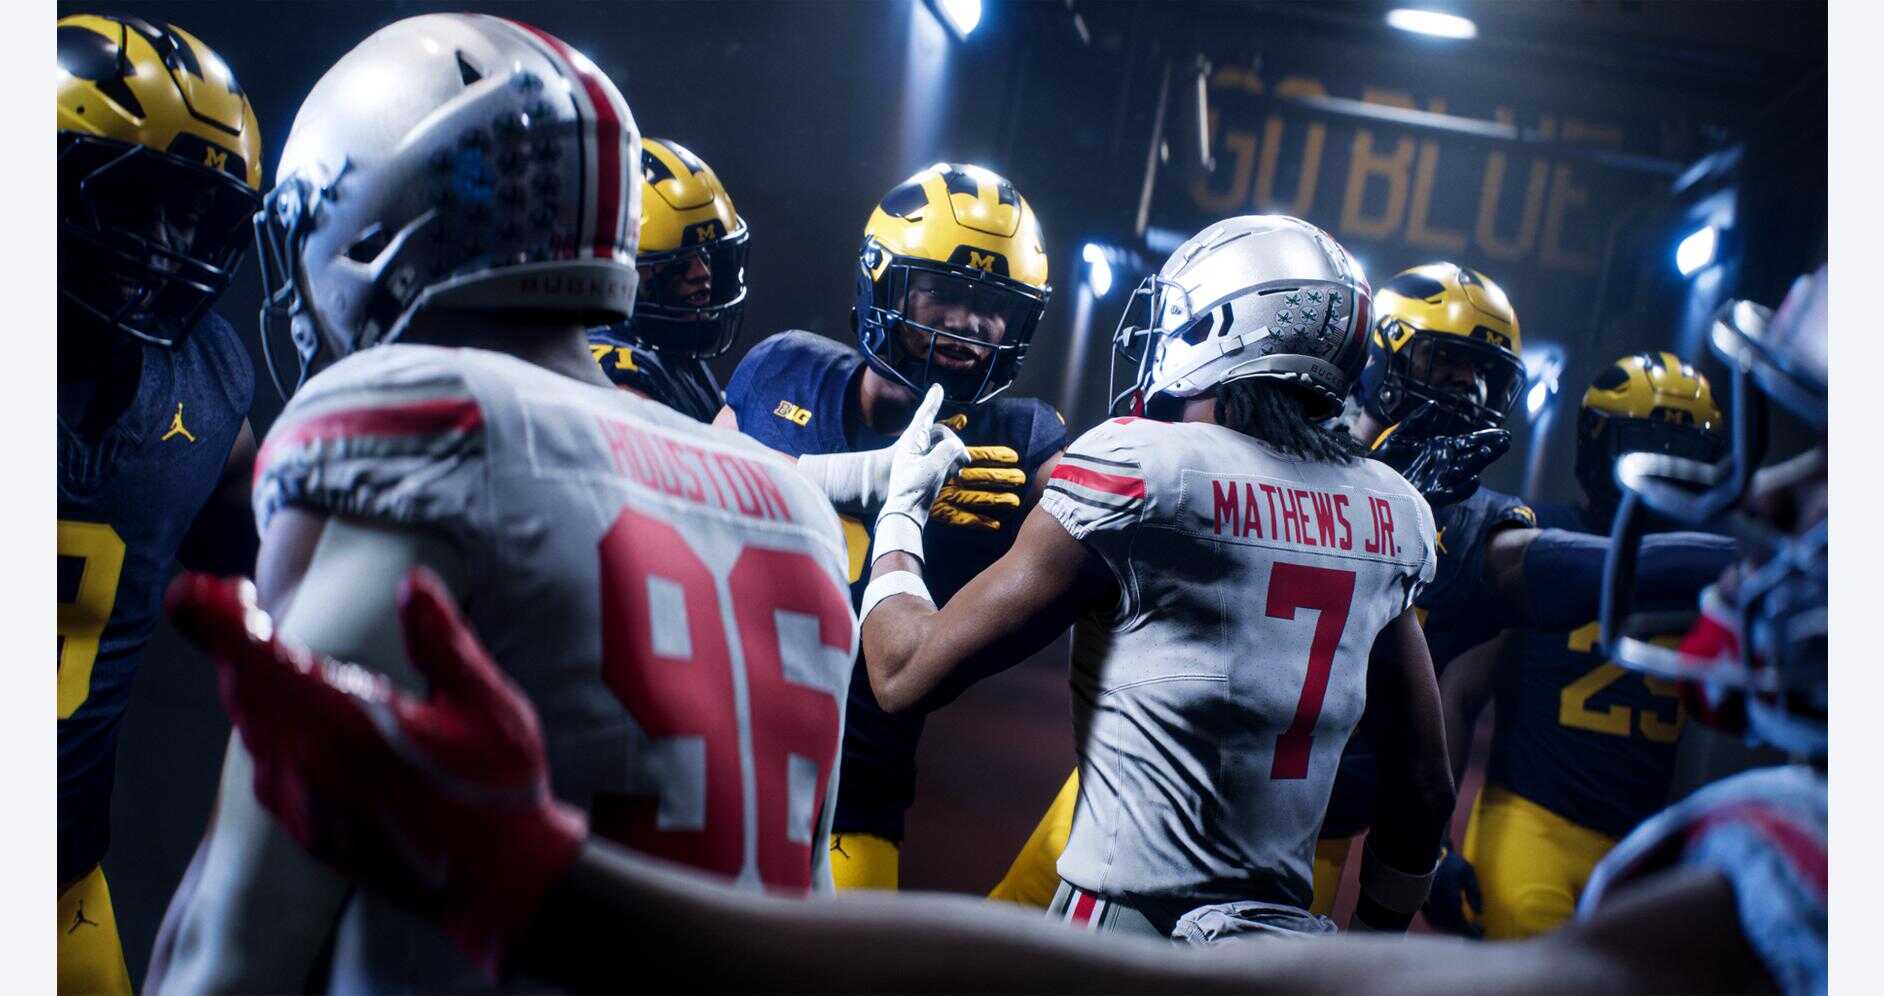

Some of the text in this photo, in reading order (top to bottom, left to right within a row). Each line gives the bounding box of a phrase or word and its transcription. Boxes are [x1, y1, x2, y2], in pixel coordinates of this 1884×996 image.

[203, 146, 227, 173] M
[1340, 87, 1623, 275] BLUE
[696, 224, 716, 241] M
[968, 251, 995, 273] M
[1486, 330, 1504, 347] M
[595, 412, 792, 523] HOUSTON
[1212, 480, 1402, 557] MATHEWS JR.
[598, 505, 854, 898] 96
[1265, 561, 1357, 780] 7
